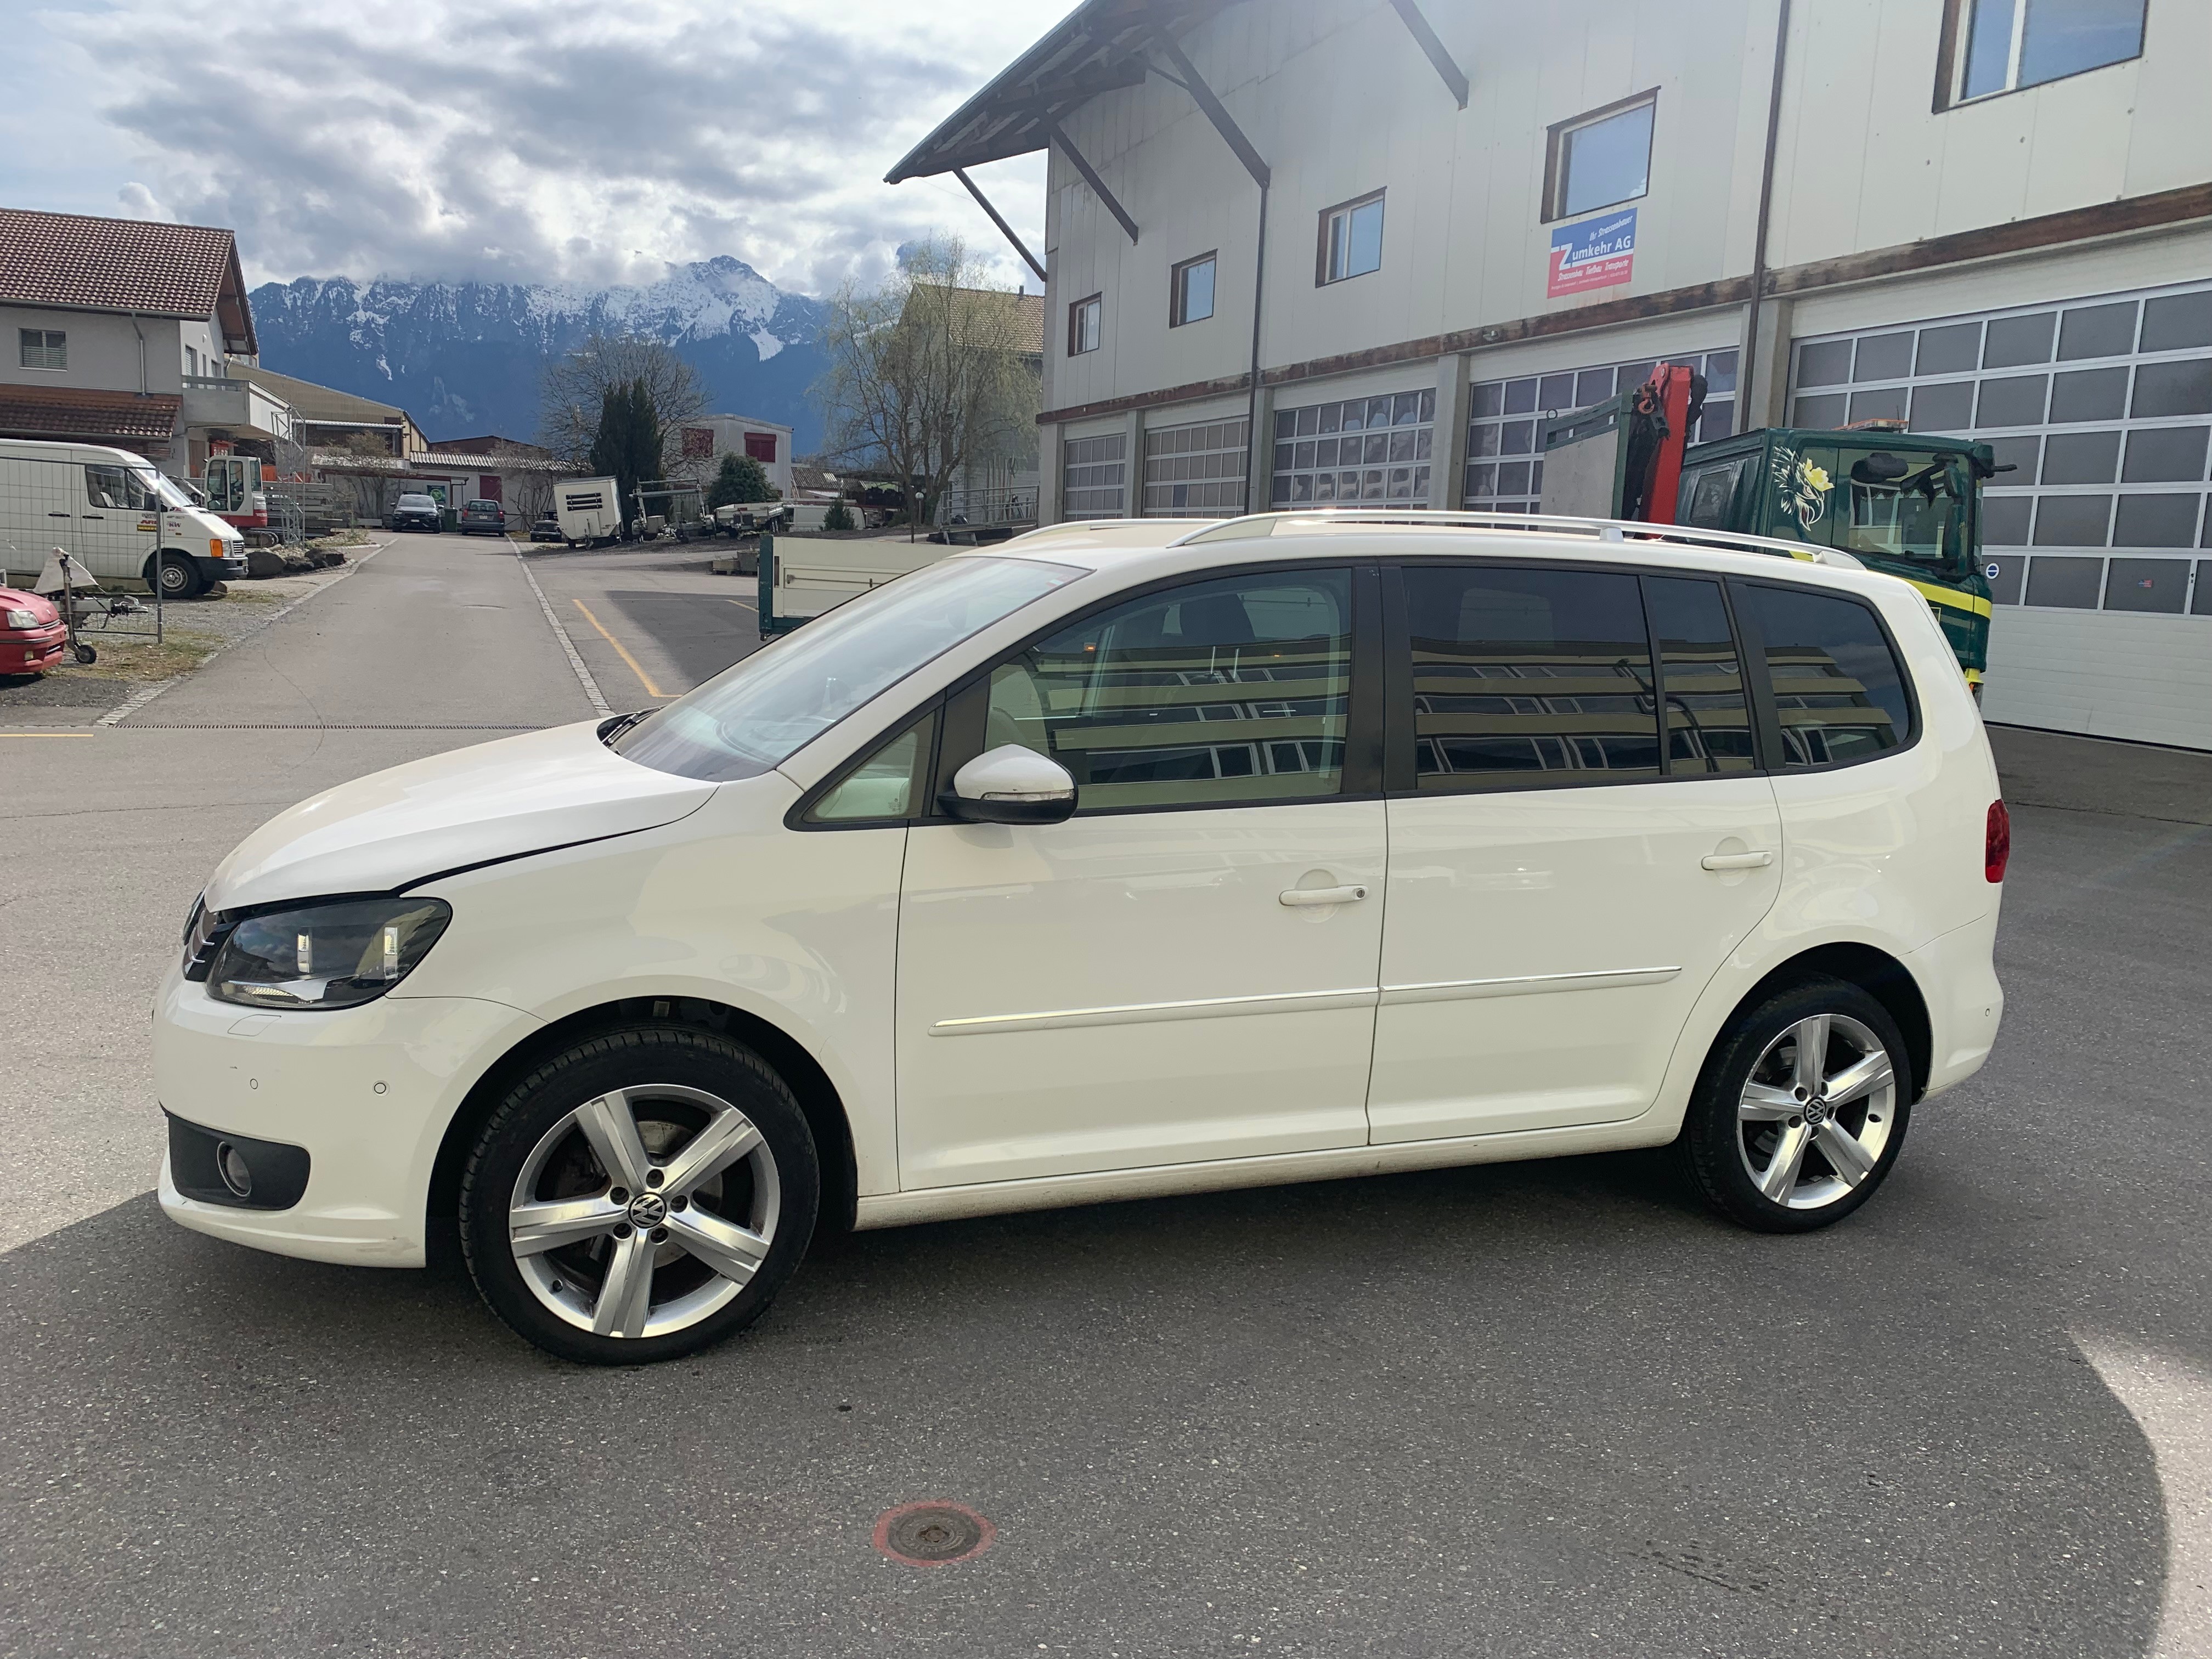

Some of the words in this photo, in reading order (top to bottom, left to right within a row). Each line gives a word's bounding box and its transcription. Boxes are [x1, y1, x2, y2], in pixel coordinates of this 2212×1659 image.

[1559, 241, 1612, 270] Zumkehr
[1615, 235, 1631, 251] AG
[1805, 1098, 1825, 1124] VW
[630, 1194, 665, 1227] VW
